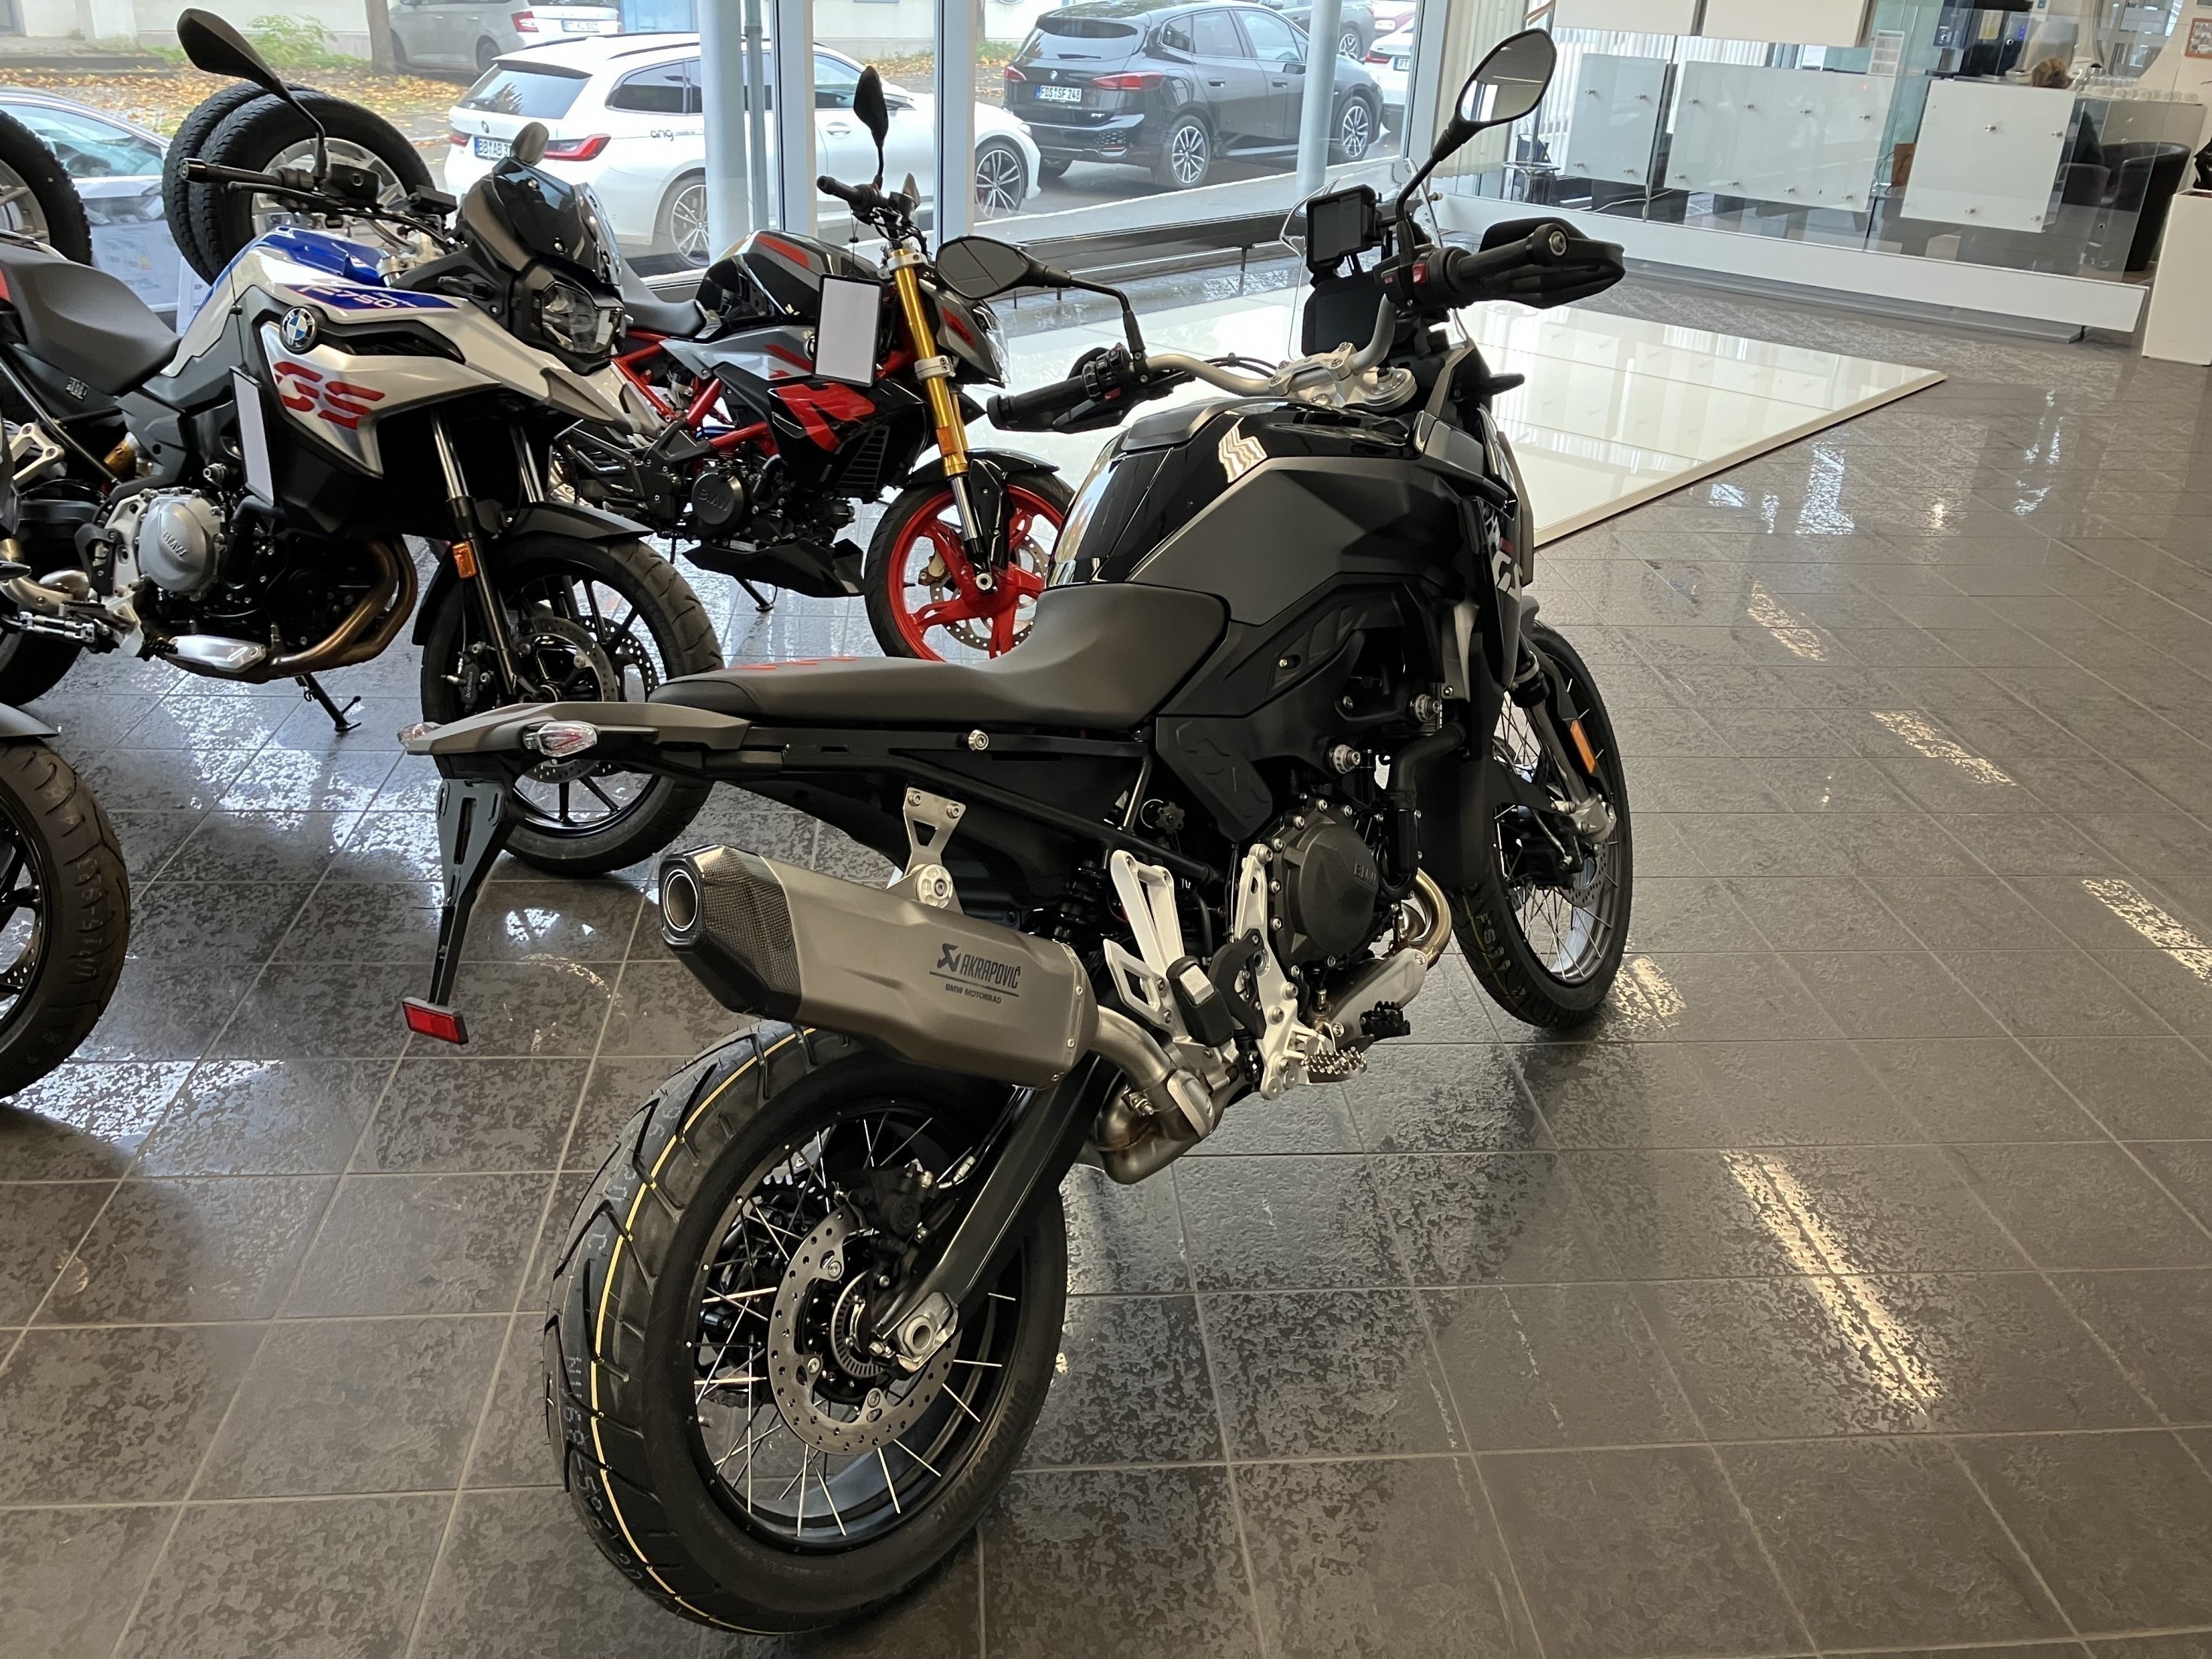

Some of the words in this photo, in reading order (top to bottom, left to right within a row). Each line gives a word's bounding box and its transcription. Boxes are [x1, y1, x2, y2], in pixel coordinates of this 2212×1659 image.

[1067, 89, 1081, 100] 248
[479, 141, 488, 154] BB
[493, 143, 502, 156] AB
[273, 361, 386, 431] GS
[698, 489, 730, 512] BMW
[162, 529, 187, 557] BMW
[945, 983, 963, 994] BMW
[965, 988, 1003, 1005] MOTORRAD
